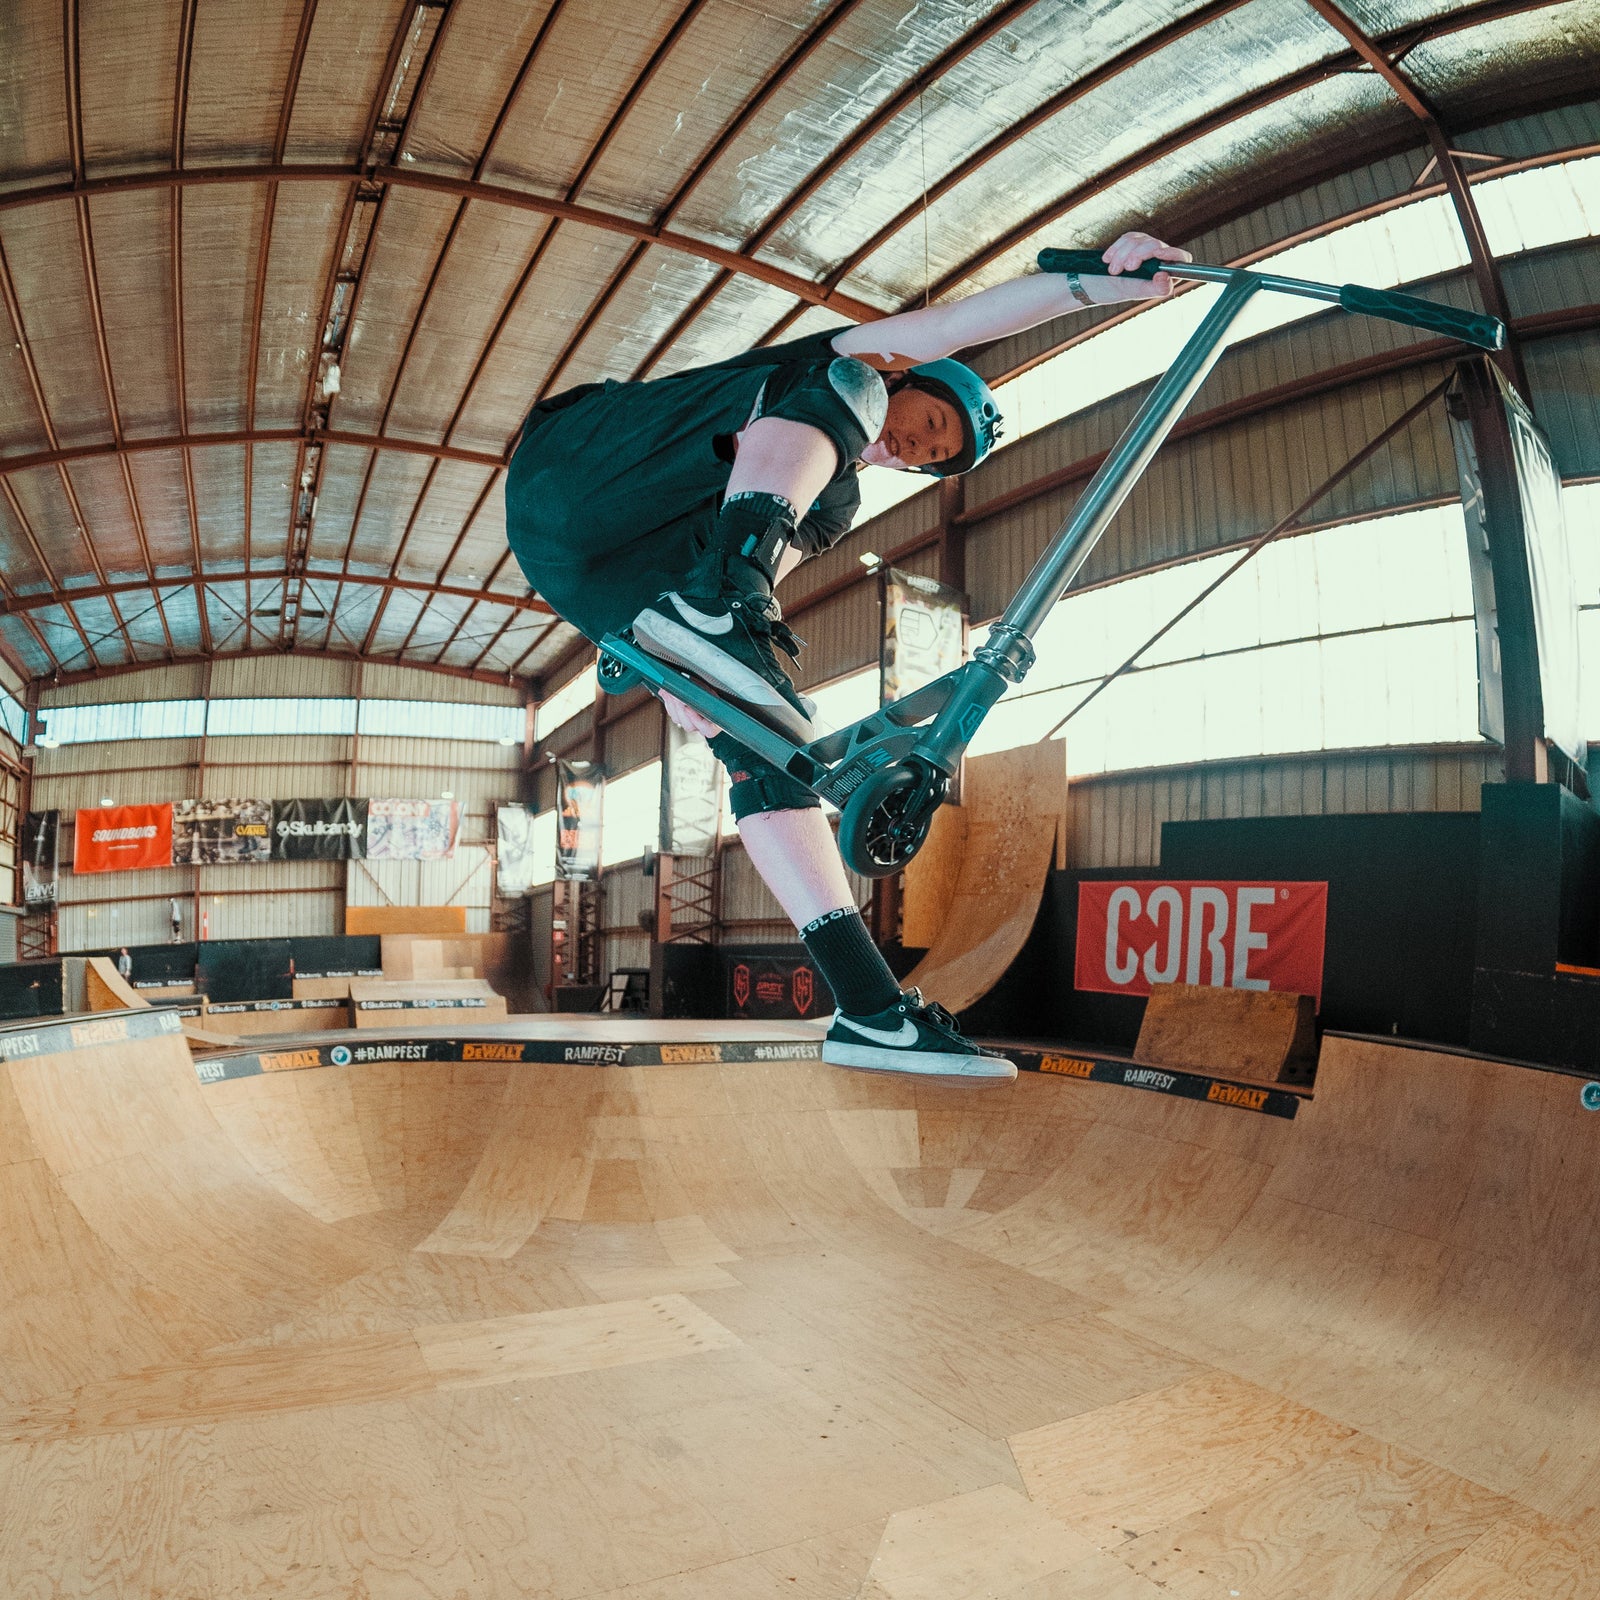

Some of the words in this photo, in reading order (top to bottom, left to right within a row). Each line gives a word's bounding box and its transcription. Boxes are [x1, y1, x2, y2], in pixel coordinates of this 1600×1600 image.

[289, 820, 363, 839] Skullcandy
[565, 1046, 626, 1063] RAMPFEST
[754, 1045, 819, 1060] #RAMPFEST
[1124, 1069, 1176, 1090] RAMPFEST
